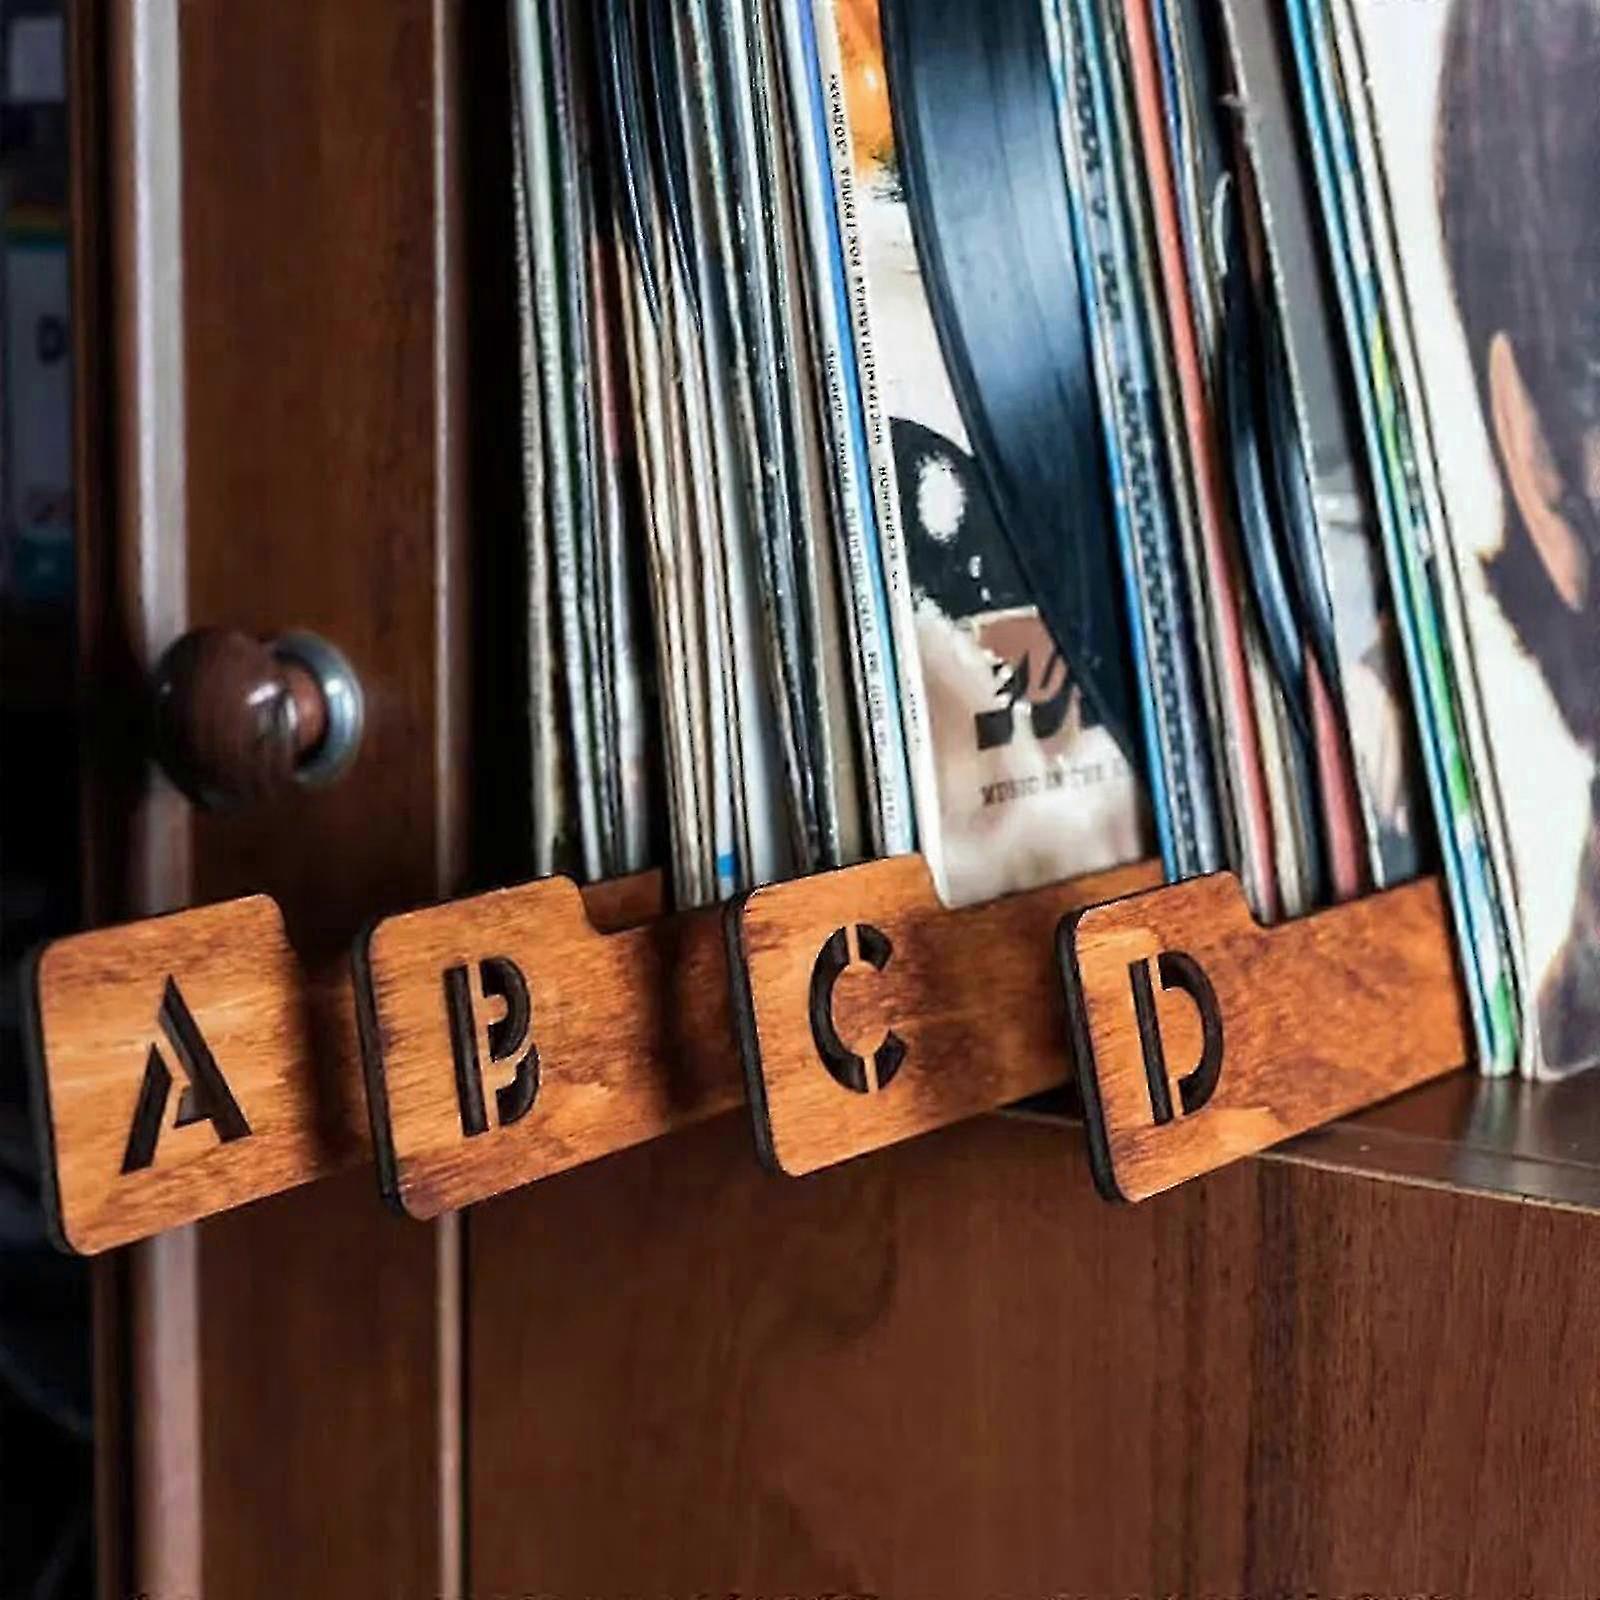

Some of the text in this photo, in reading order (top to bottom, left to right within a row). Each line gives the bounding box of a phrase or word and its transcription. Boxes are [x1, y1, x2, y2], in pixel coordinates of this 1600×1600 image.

[120, 973, 252, 1174] A
[444, 956, 541, 1137] B
[809, 924, 907, 1093] C
[1128, 951, 1224, 1125] D
